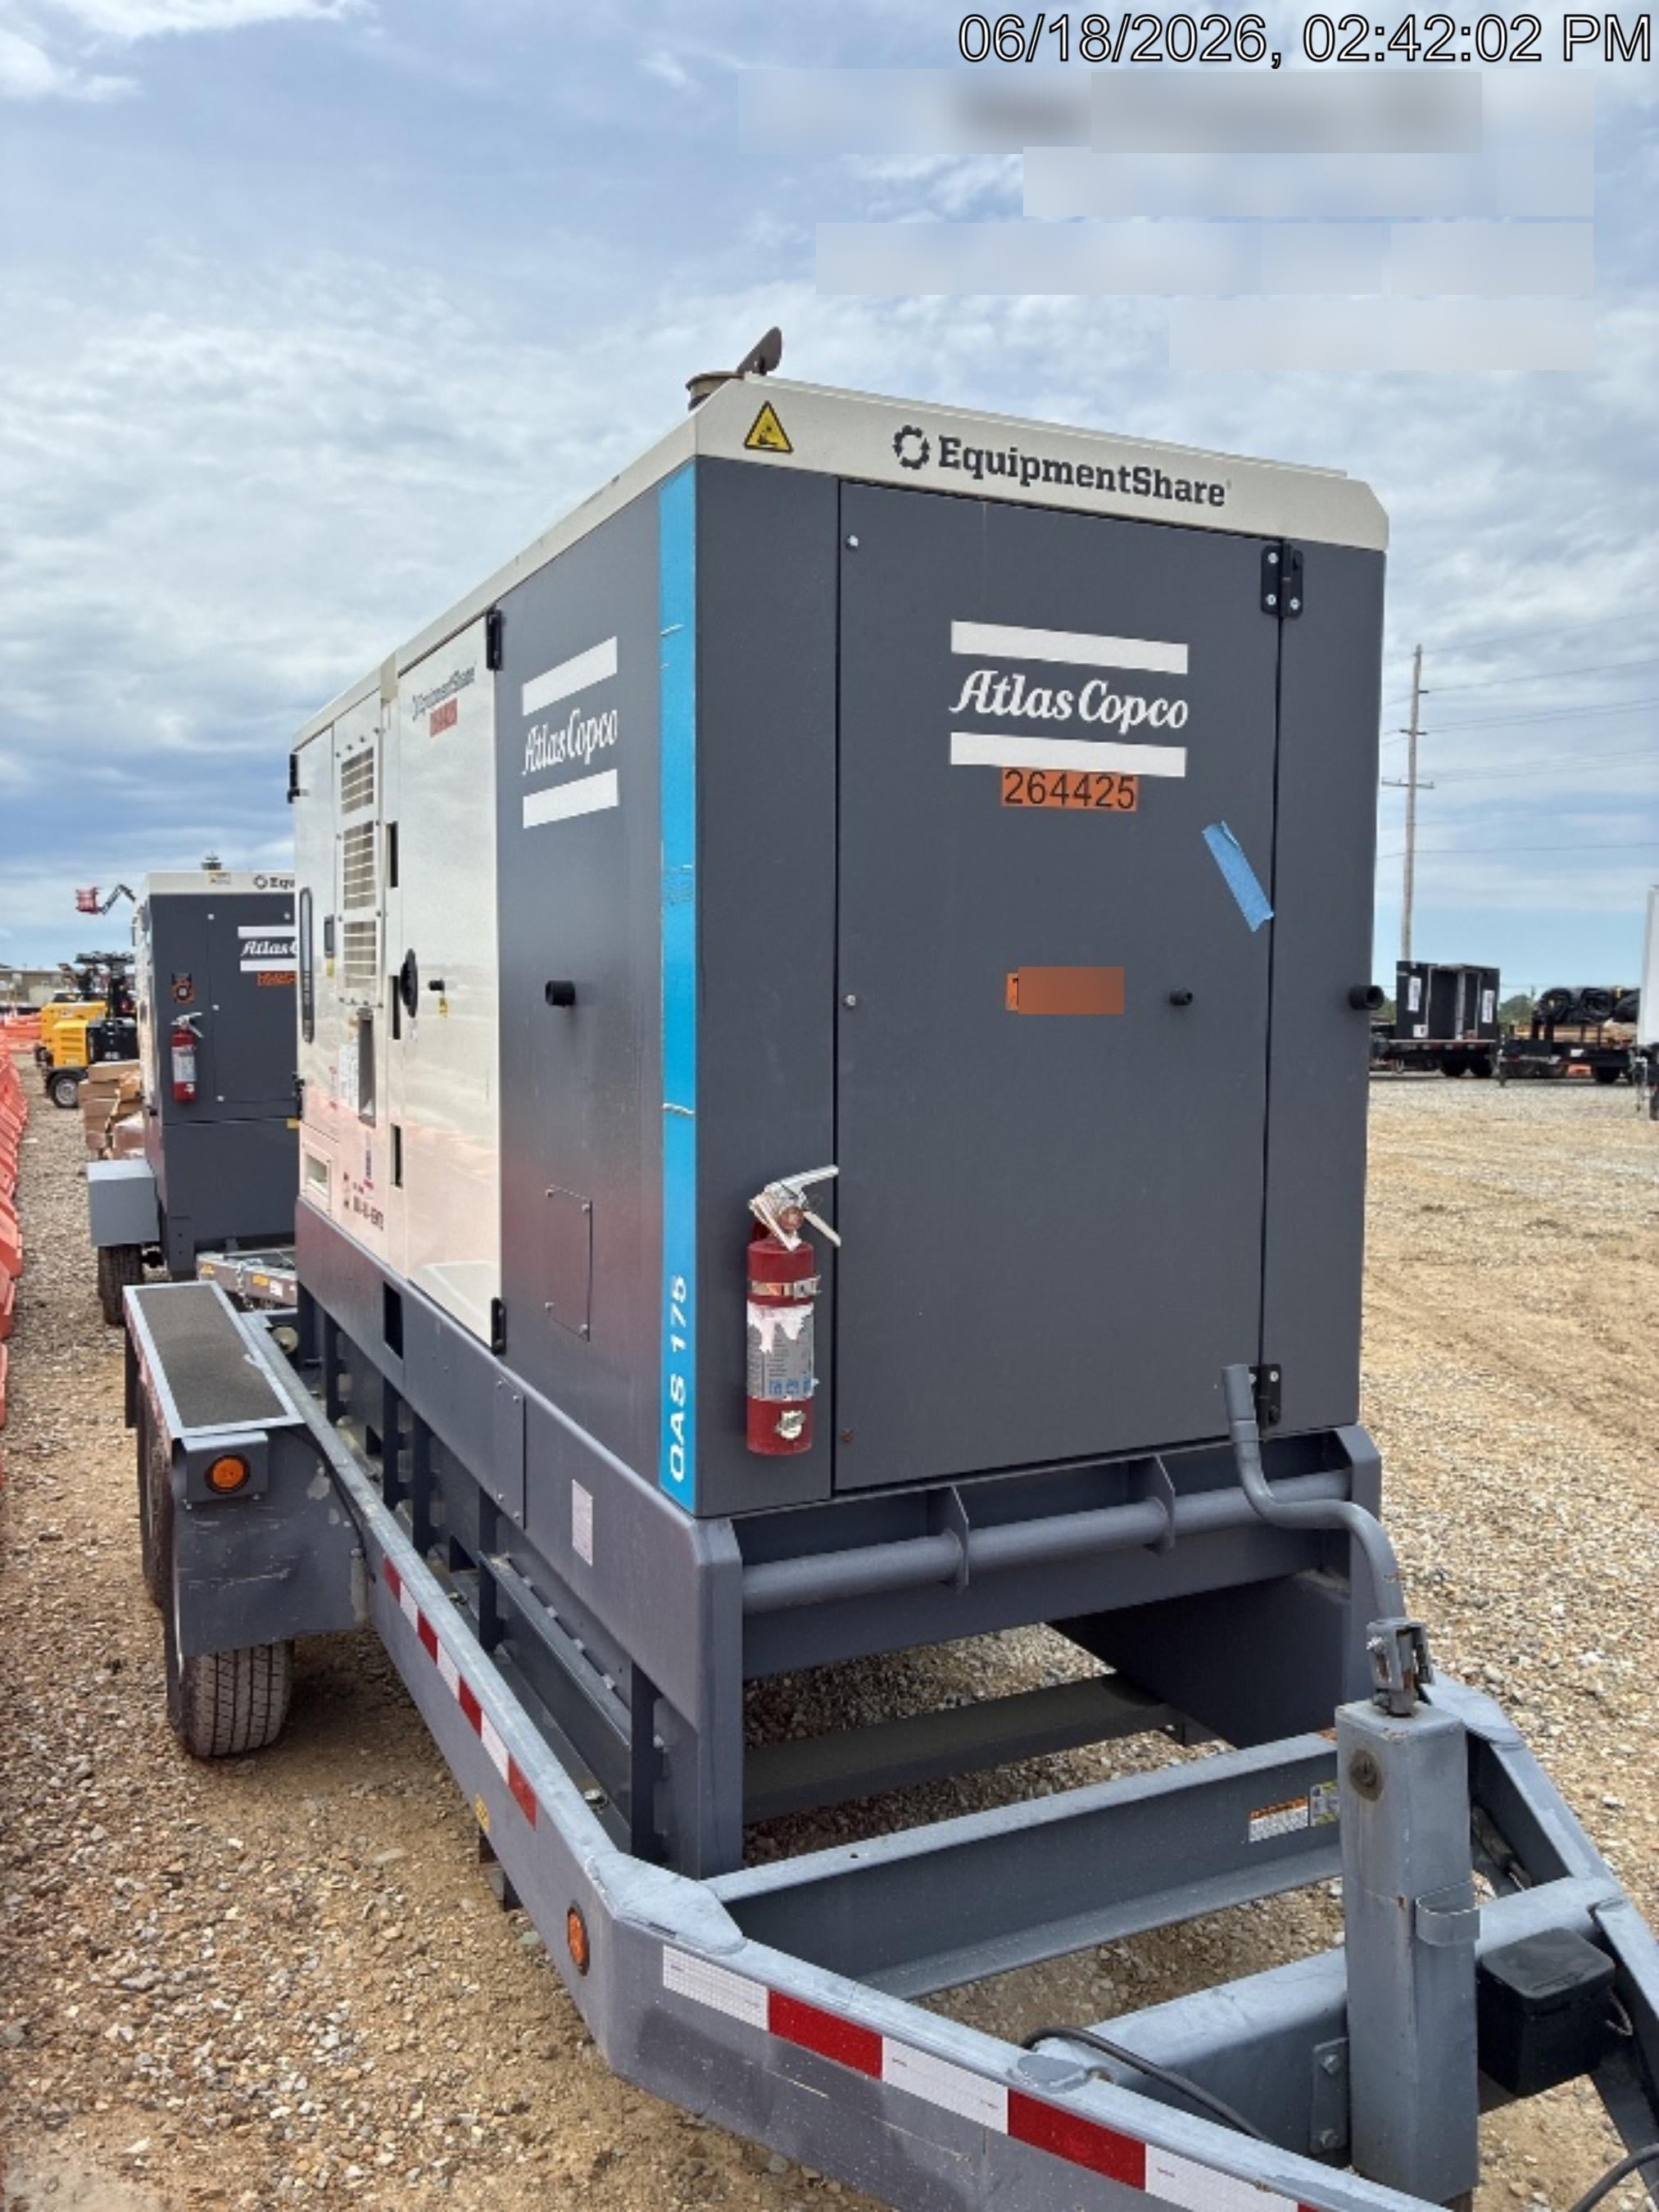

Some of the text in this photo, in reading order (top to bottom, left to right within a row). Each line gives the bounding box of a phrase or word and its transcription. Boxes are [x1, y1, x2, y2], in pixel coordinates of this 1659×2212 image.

[938, 435, 1226, 506] EquipmentShare
[949, 670, 1188, 735] Atlas Copco
[521, 708, 618, 776] Atlas Copco
[1004, 769, 1135, 810] 264425
[242, 941, 288, 956] Atlas
[669, 1373, 686, 1483] QAS
